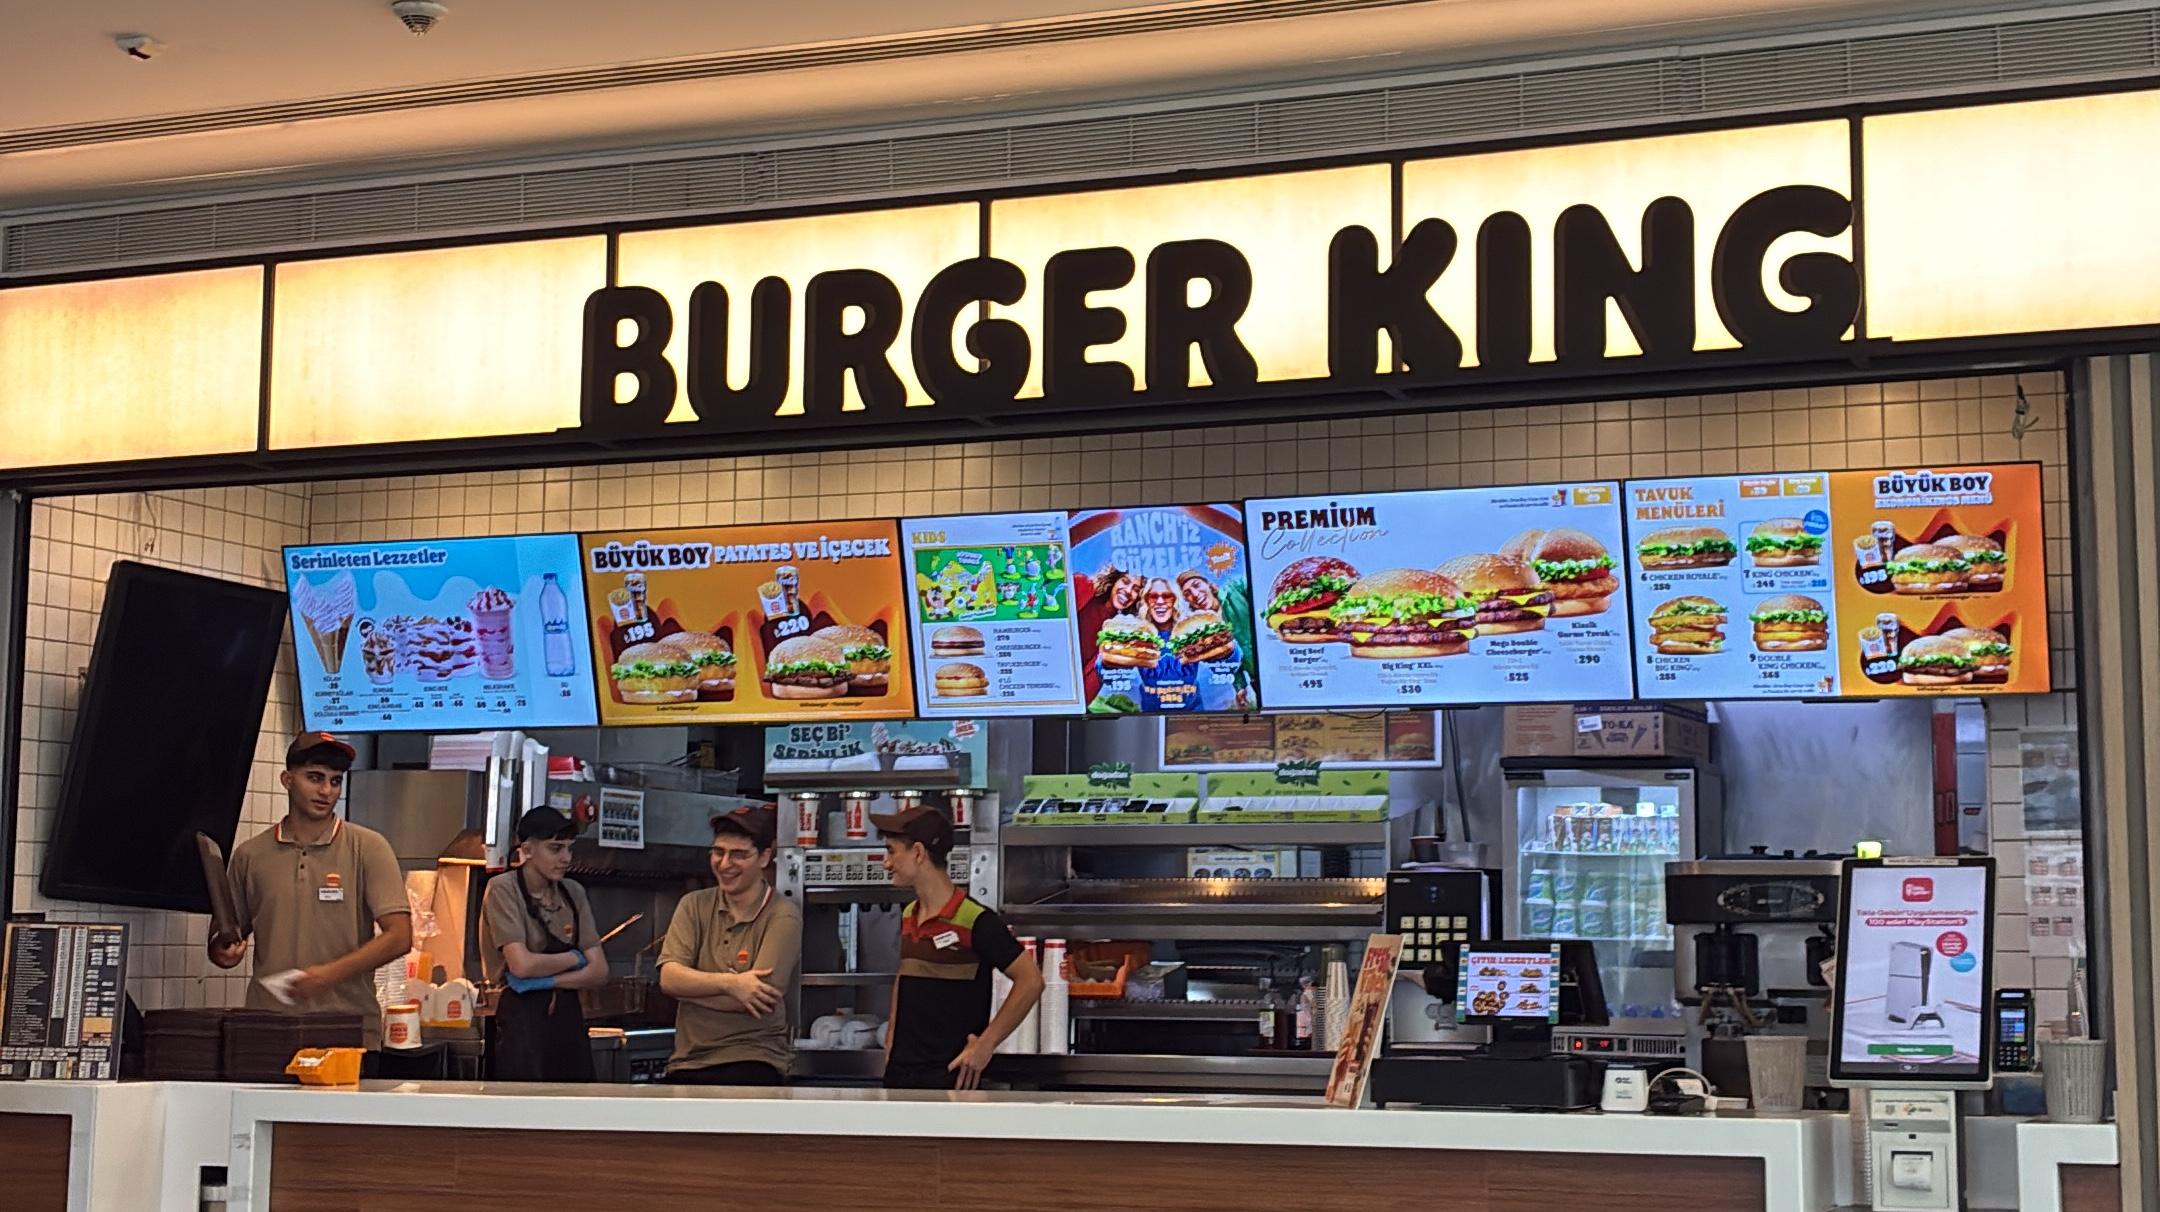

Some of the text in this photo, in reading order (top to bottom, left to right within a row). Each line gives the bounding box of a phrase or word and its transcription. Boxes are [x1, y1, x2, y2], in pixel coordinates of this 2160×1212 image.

[581, 184, 1861, 428] BURGER KING
[1635, 487, 1694, 502] TAVUK
[1878, 474, 1989, 495] BÜYÜK BOY
[1636, 499, 1725, 520] MENÜLERİ
[595, 536, 891, 569] BÜYÜK BOY PATATES VE İÇECEK
[1261, 526, 1389, 560] Collection
[291, 548, 446, 570] Serinleten Lezzetler
[1641, 573, 1648, 582] 6
[791, 726, 823, 747] SEÇ
